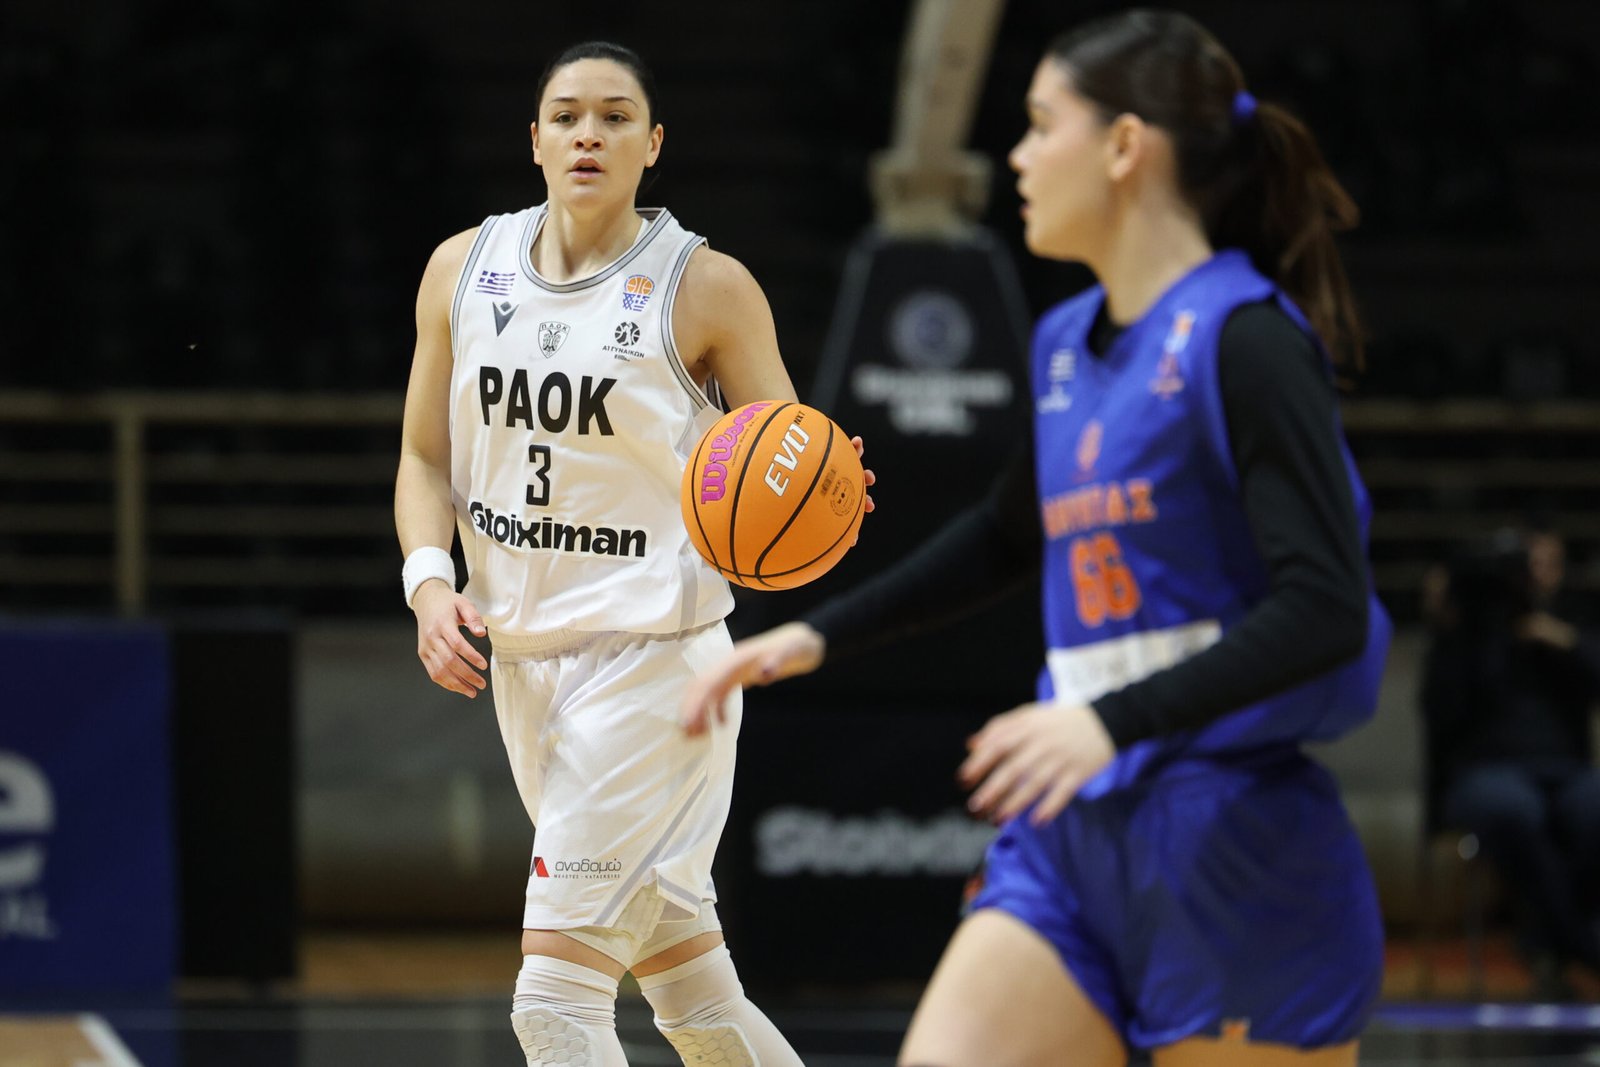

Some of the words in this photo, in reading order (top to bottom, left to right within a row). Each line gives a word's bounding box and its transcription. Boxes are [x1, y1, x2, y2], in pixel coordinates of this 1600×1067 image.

[479, 366, 617, 436] PAOK
[526, 444, 552, 506] 3
[469, 501, 647, 558] Stoiximan
